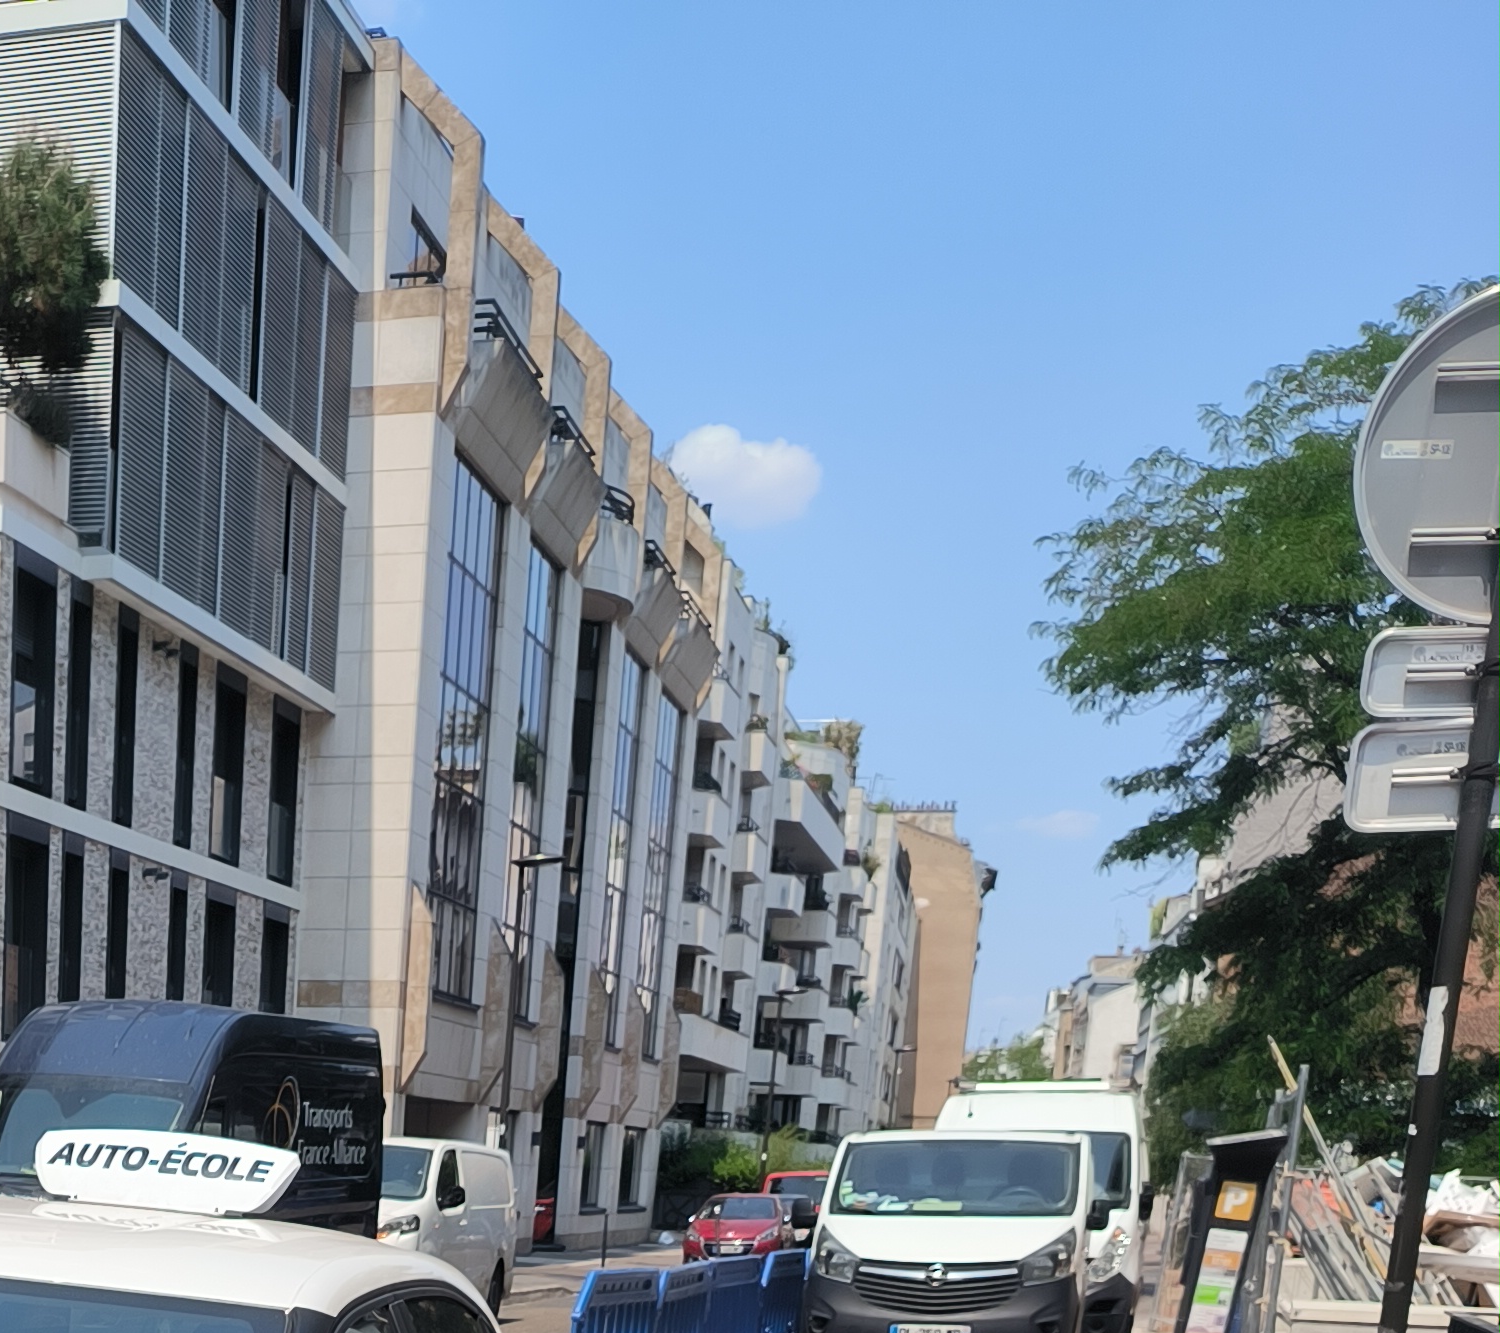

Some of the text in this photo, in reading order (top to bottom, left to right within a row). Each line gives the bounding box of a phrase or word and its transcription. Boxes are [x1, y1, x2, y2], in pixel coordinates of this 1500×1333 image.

[303, 1101, 353, 1134] Transports
[46, 1141, 275, 1183] AUTO-ÉCOLE
[298, 1138, 367, 1165] France Alliance
[1223, 1187, 1249, 1215] P
